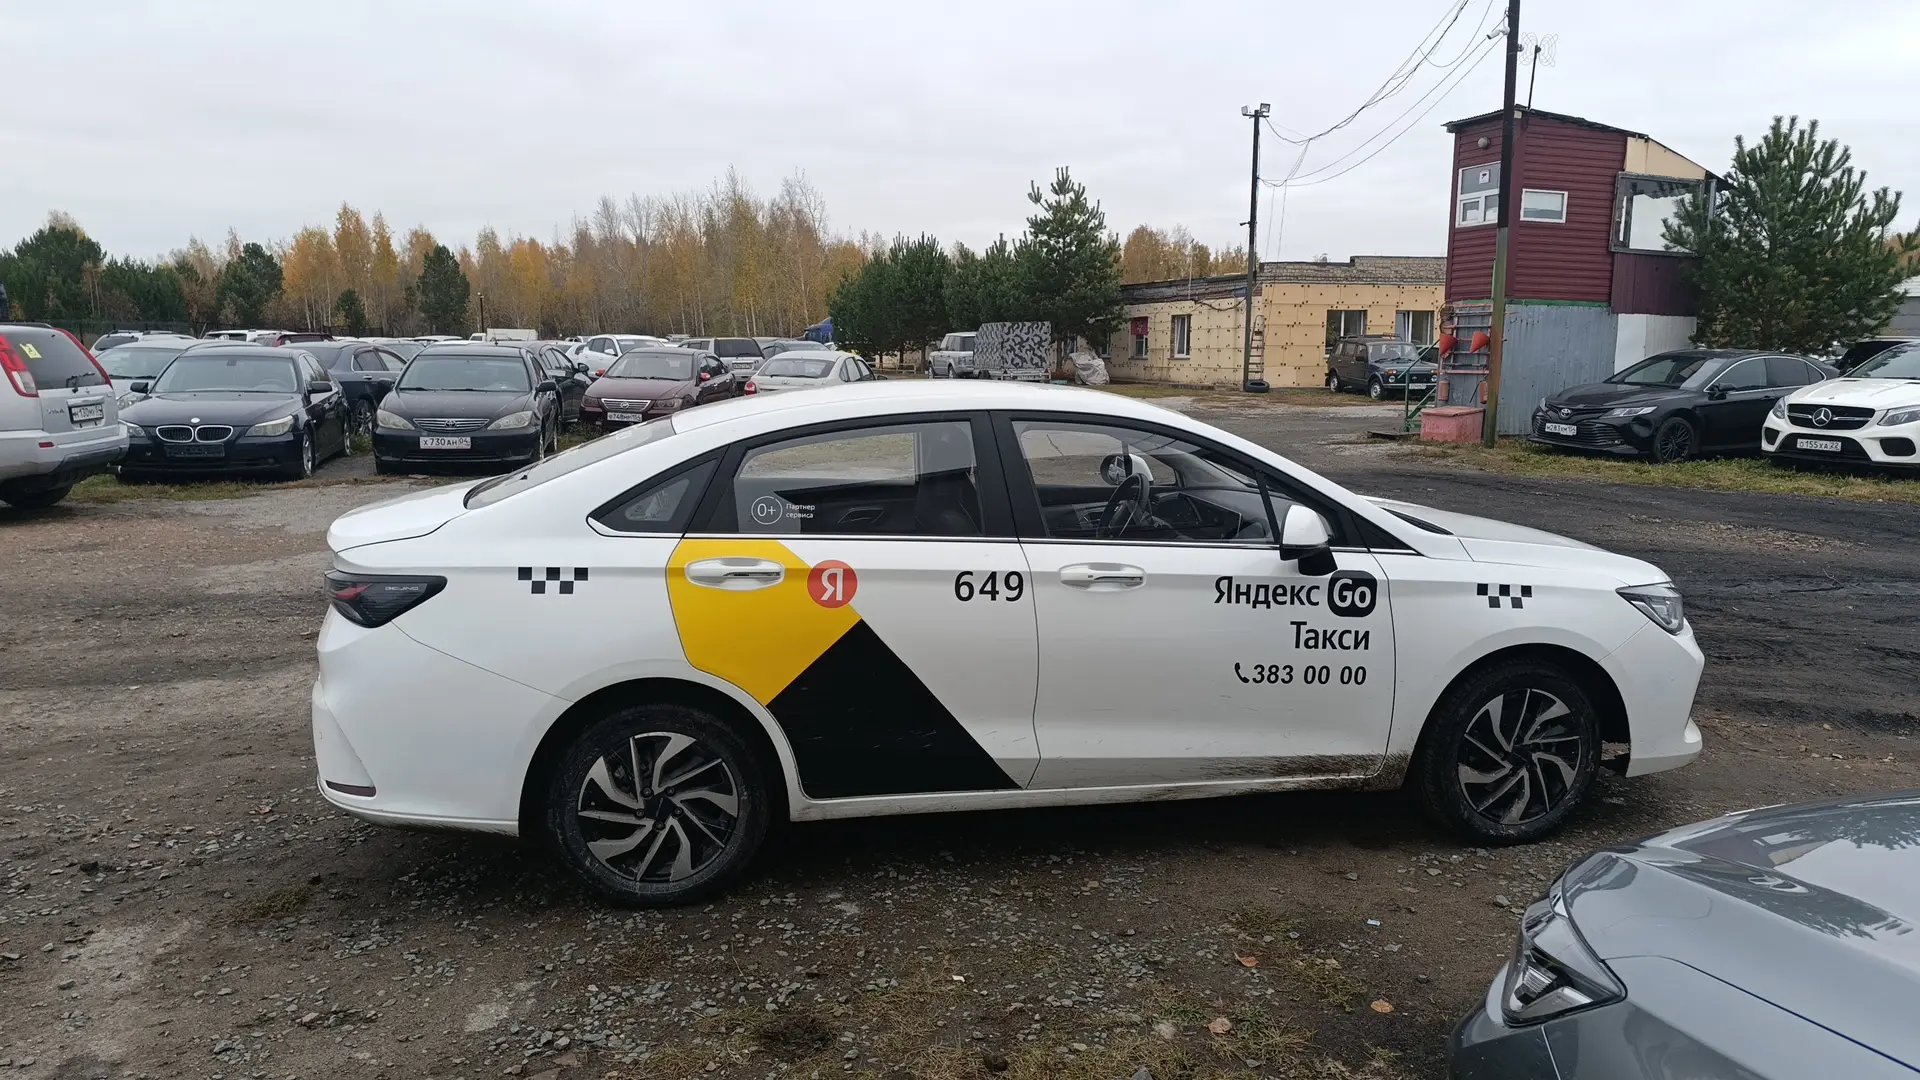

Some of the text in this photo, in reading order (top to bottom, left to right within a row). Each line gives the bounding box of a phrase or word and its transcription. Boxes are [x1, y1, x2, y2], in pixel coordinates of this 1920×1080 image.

[786, 503, 815, 511] Партнер
[820, 567, 844, 601] Я
[954, 570, 1024, 602] 649
[1214, 575, 1373, 610] Яндекс Go
[1290, 620, 1370, 651] Такси
[1252, 664, 1367, 686] 383 00 00
